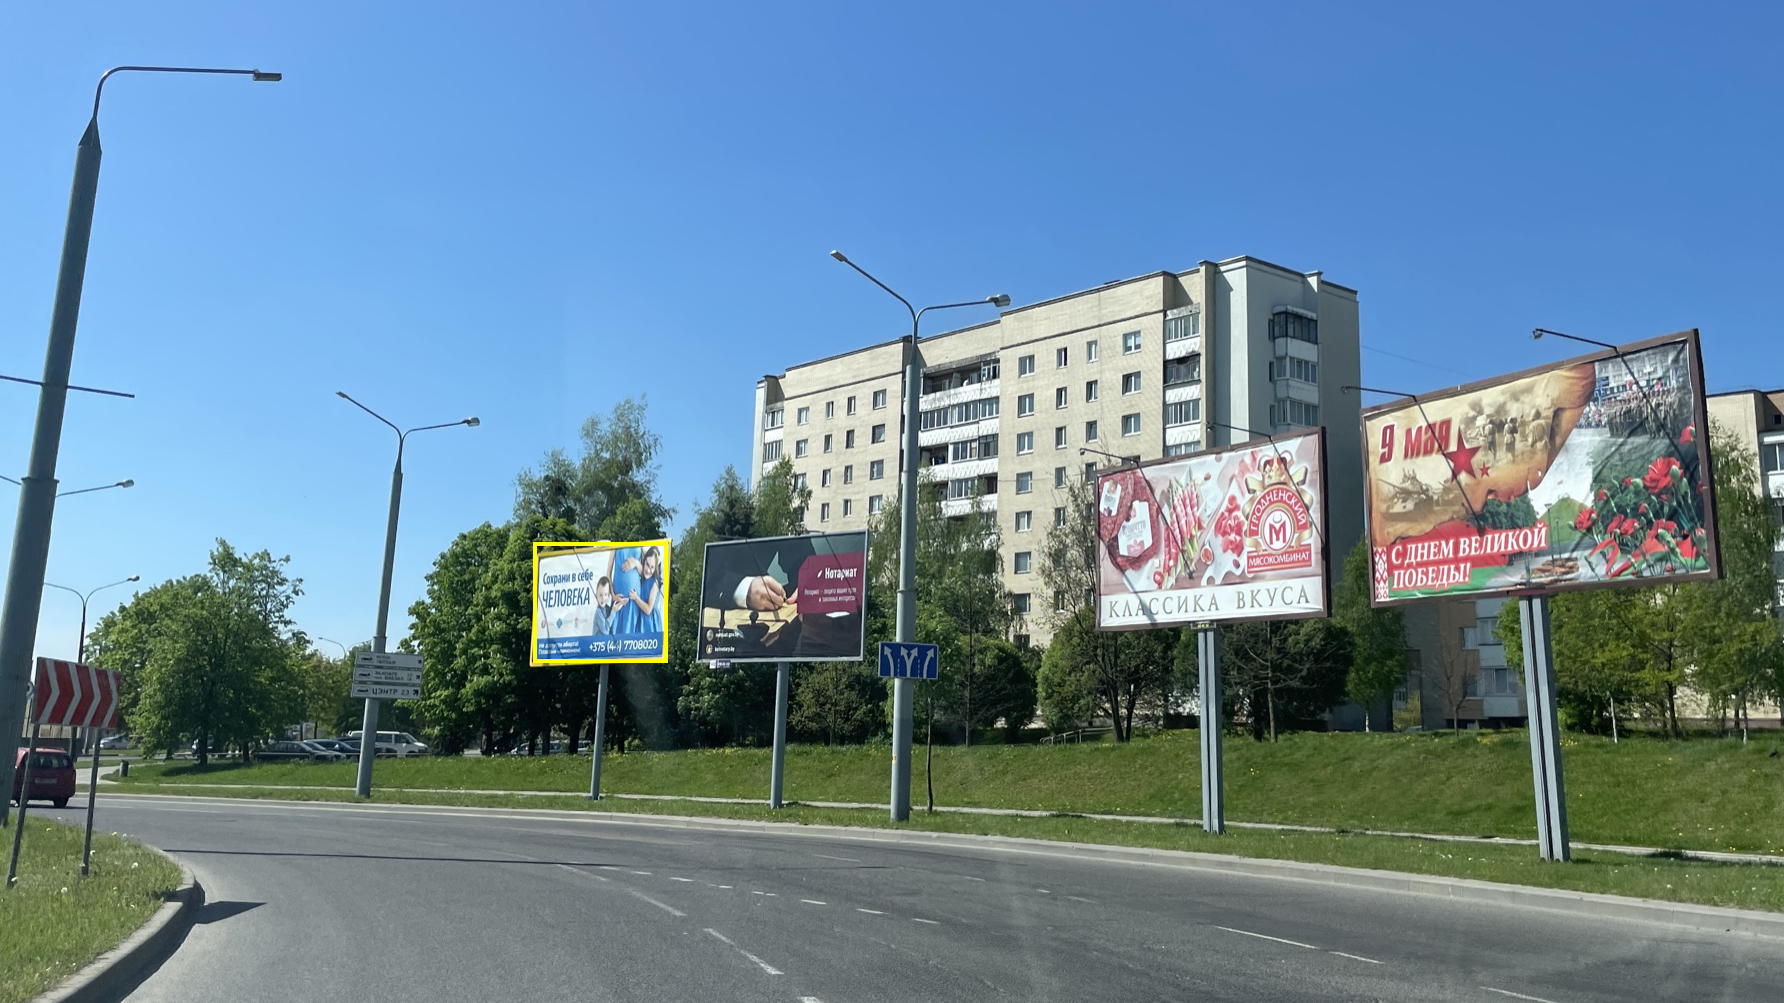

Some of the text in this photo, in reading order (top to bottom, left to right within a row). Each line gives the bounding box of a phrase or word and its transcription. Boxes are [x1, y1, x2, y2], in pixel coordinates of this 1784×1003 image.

[1379, 424, 1396, 464] 9
[1250, 488, 1308, 532] ГРОДНЕНСКИЙ
[1407, 541, 1455, 564] ДНЕМ
[1458, 523, 1547, 557] ВЕЛИКОЙ
[1249, 551, 1310, 567] МЯСОКОМБИНАТ
[543, 568, 593, 587] Сохрани в себе
[824, 567, 857, 581] Нотариат
[1392, 562, 1471, 589] ПОБЕДЫ!
[542, 587, 590, 608] ЧЕЛОВЕКА
[1109, 584, 1310, 618] КЛАССИКА ВКУСА
[589, 641, 606, 652] +375
[623, 638, 658, 650] 7708020
